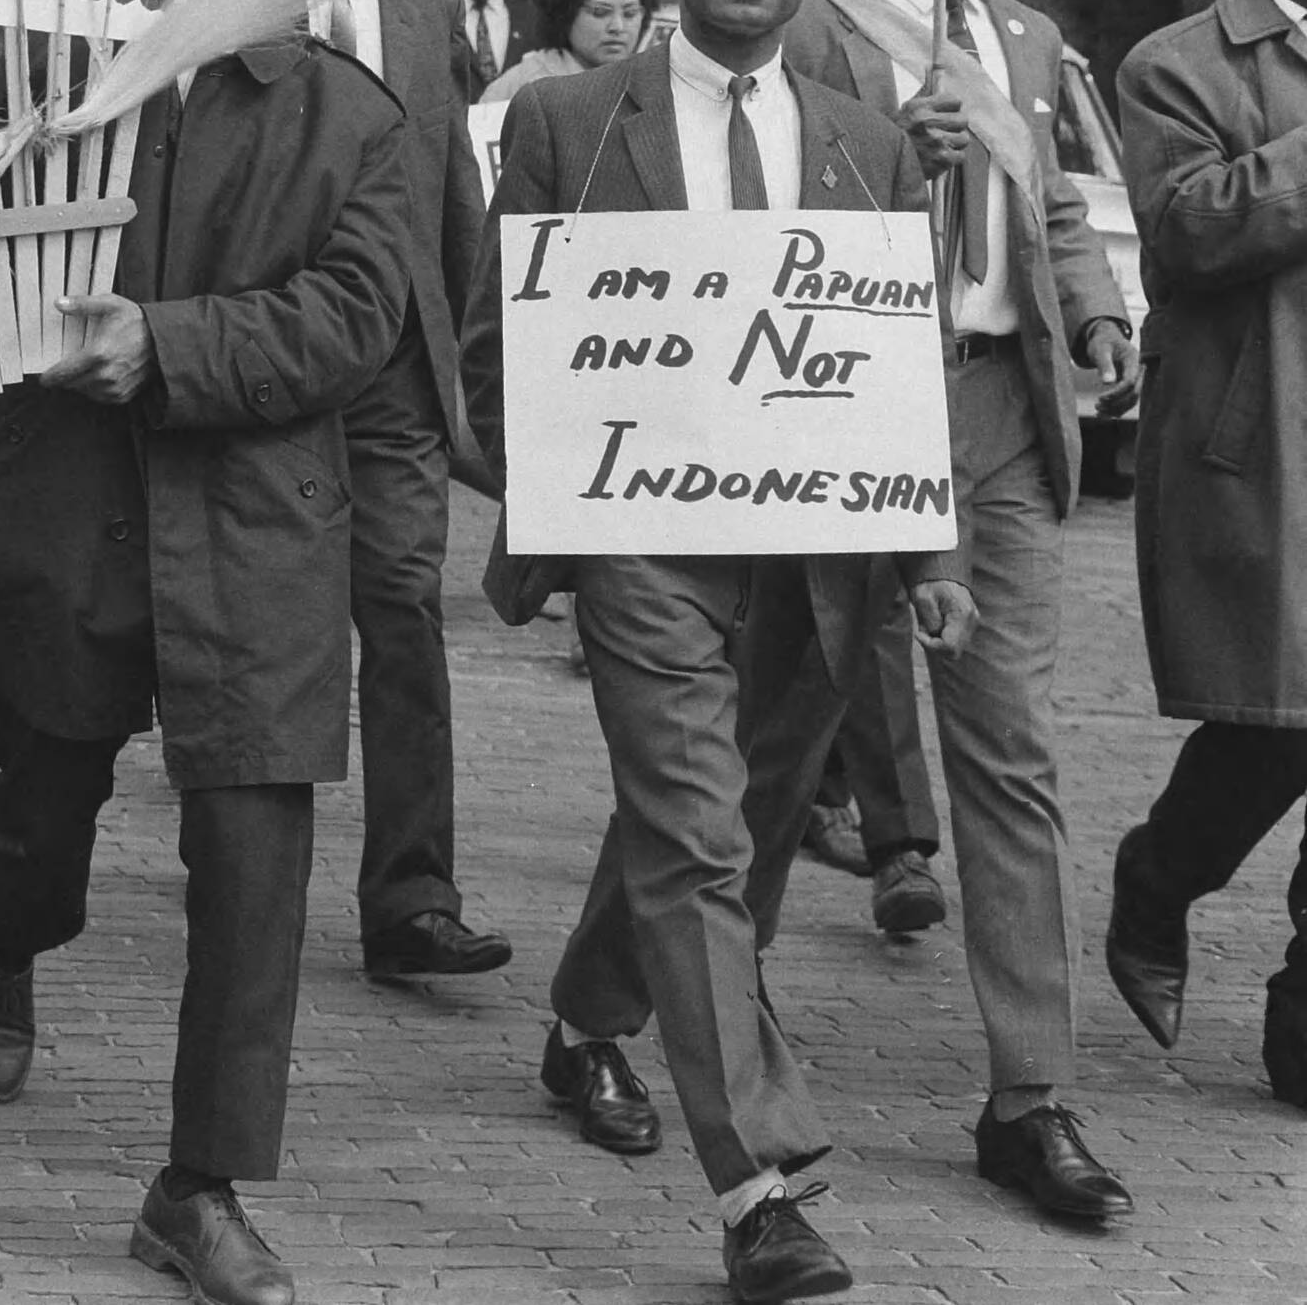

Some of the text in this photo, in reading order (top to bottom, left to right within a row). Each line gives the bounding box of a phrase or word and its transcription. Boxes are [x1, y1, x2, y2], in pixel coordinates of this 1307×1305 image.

[511, 217, 934, 309] I AM A PAPUAN
[570, 308, 872, 389] AND NOT
[578, 420, 950, 516] INDONESIAN
